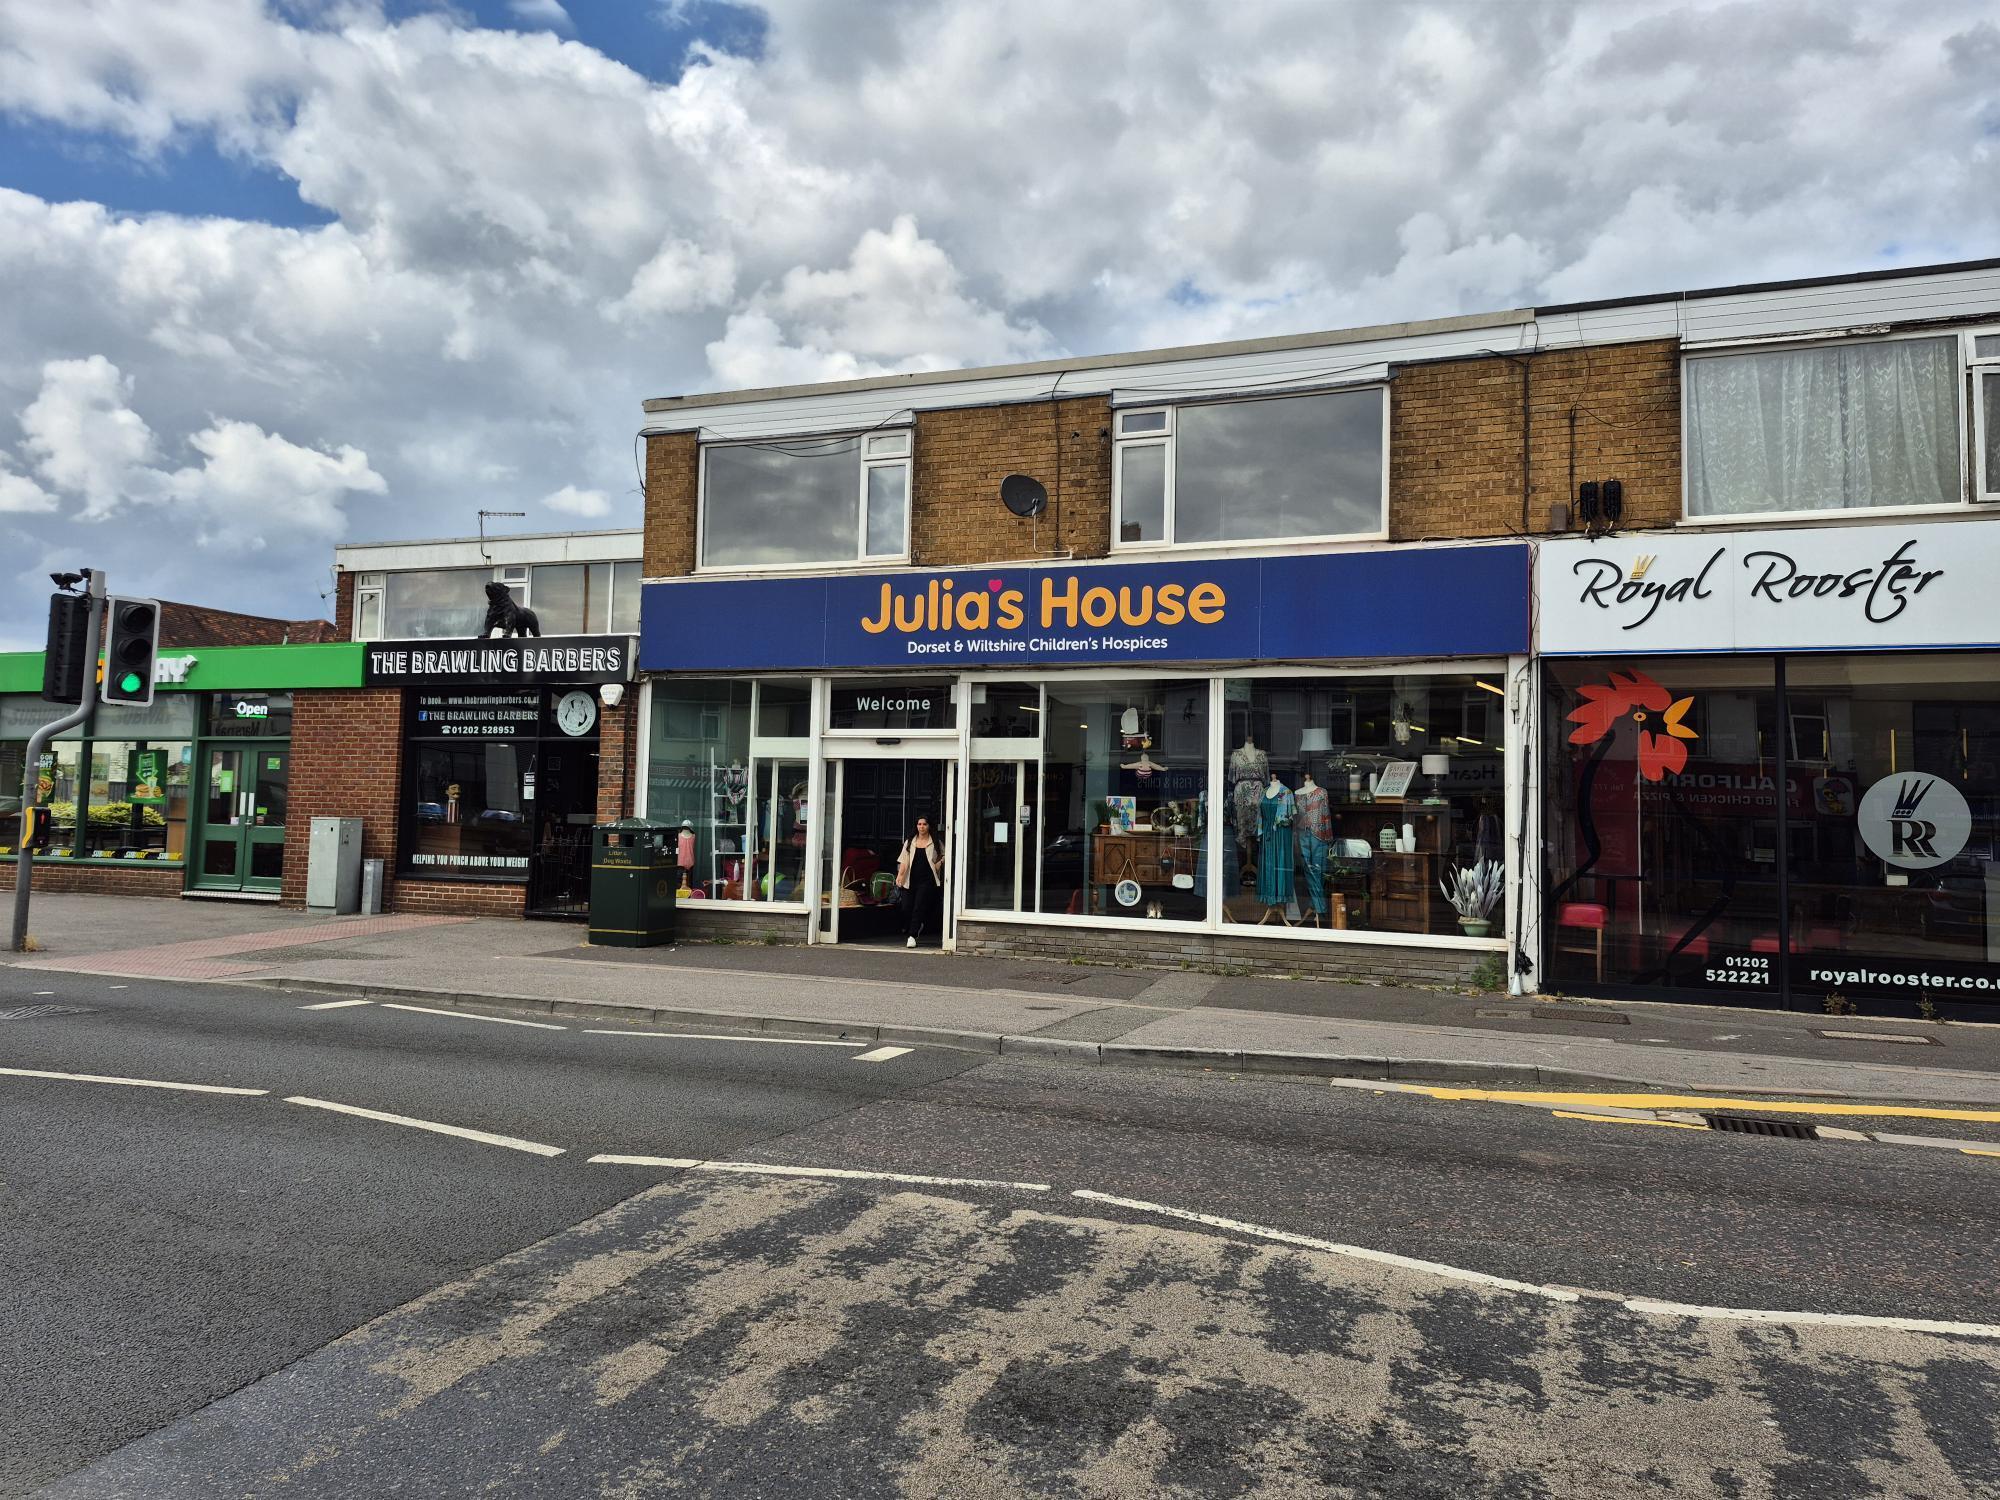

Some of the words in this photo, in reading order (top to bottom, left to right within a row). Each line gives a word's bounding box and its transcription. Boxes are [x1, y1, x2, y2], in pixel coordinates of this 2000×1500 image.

[1573, 547, 1725, 630] Royal
[1743, 539, 1944, 624] Rooster
[861, 578, 1024, 633] Julia's
[1041, 576, 1226, 628] House
[907, 639, 951, 654] Dorset
[954, 640, 963, 652] &
[967, 638, 1026, 653] Wiltshire
[1029, 637, 1098, 652] Children's
[1102, 636, 1168, 652] Hospices
[371, 651, 408, 675] THE
[411, 648, 519, 674] BRAWLING
[522, 647, 621, 673] BARBERS
[420, 696, 427, 704] To
[857, 696, 931, 711] Welcome
[236, 701, 268, 718] Open
[428, 710, 446, 721] THE
[447, 710, 495, 721] BRAWLING
[497, 710, 539, 721] BARBERS
[451, 726, 479, 734] 01202
[481, 726, 515, 734] 528953
[412, 853, 435, 865] HELPING
[437, 854, 448, 865] YOU
[449, 855, 469, 866] PUNCH
[469, 856, 489, 867] ABOVE
[490, 856, 505, 867] YOUR
[506, 857, 529, 868] WEIGHT
[1725, 956, 1769, 968] 01202
[1706, 969, 1770, 985] 522221
[1810, 968, 2000, 990] royalrooster.co.
